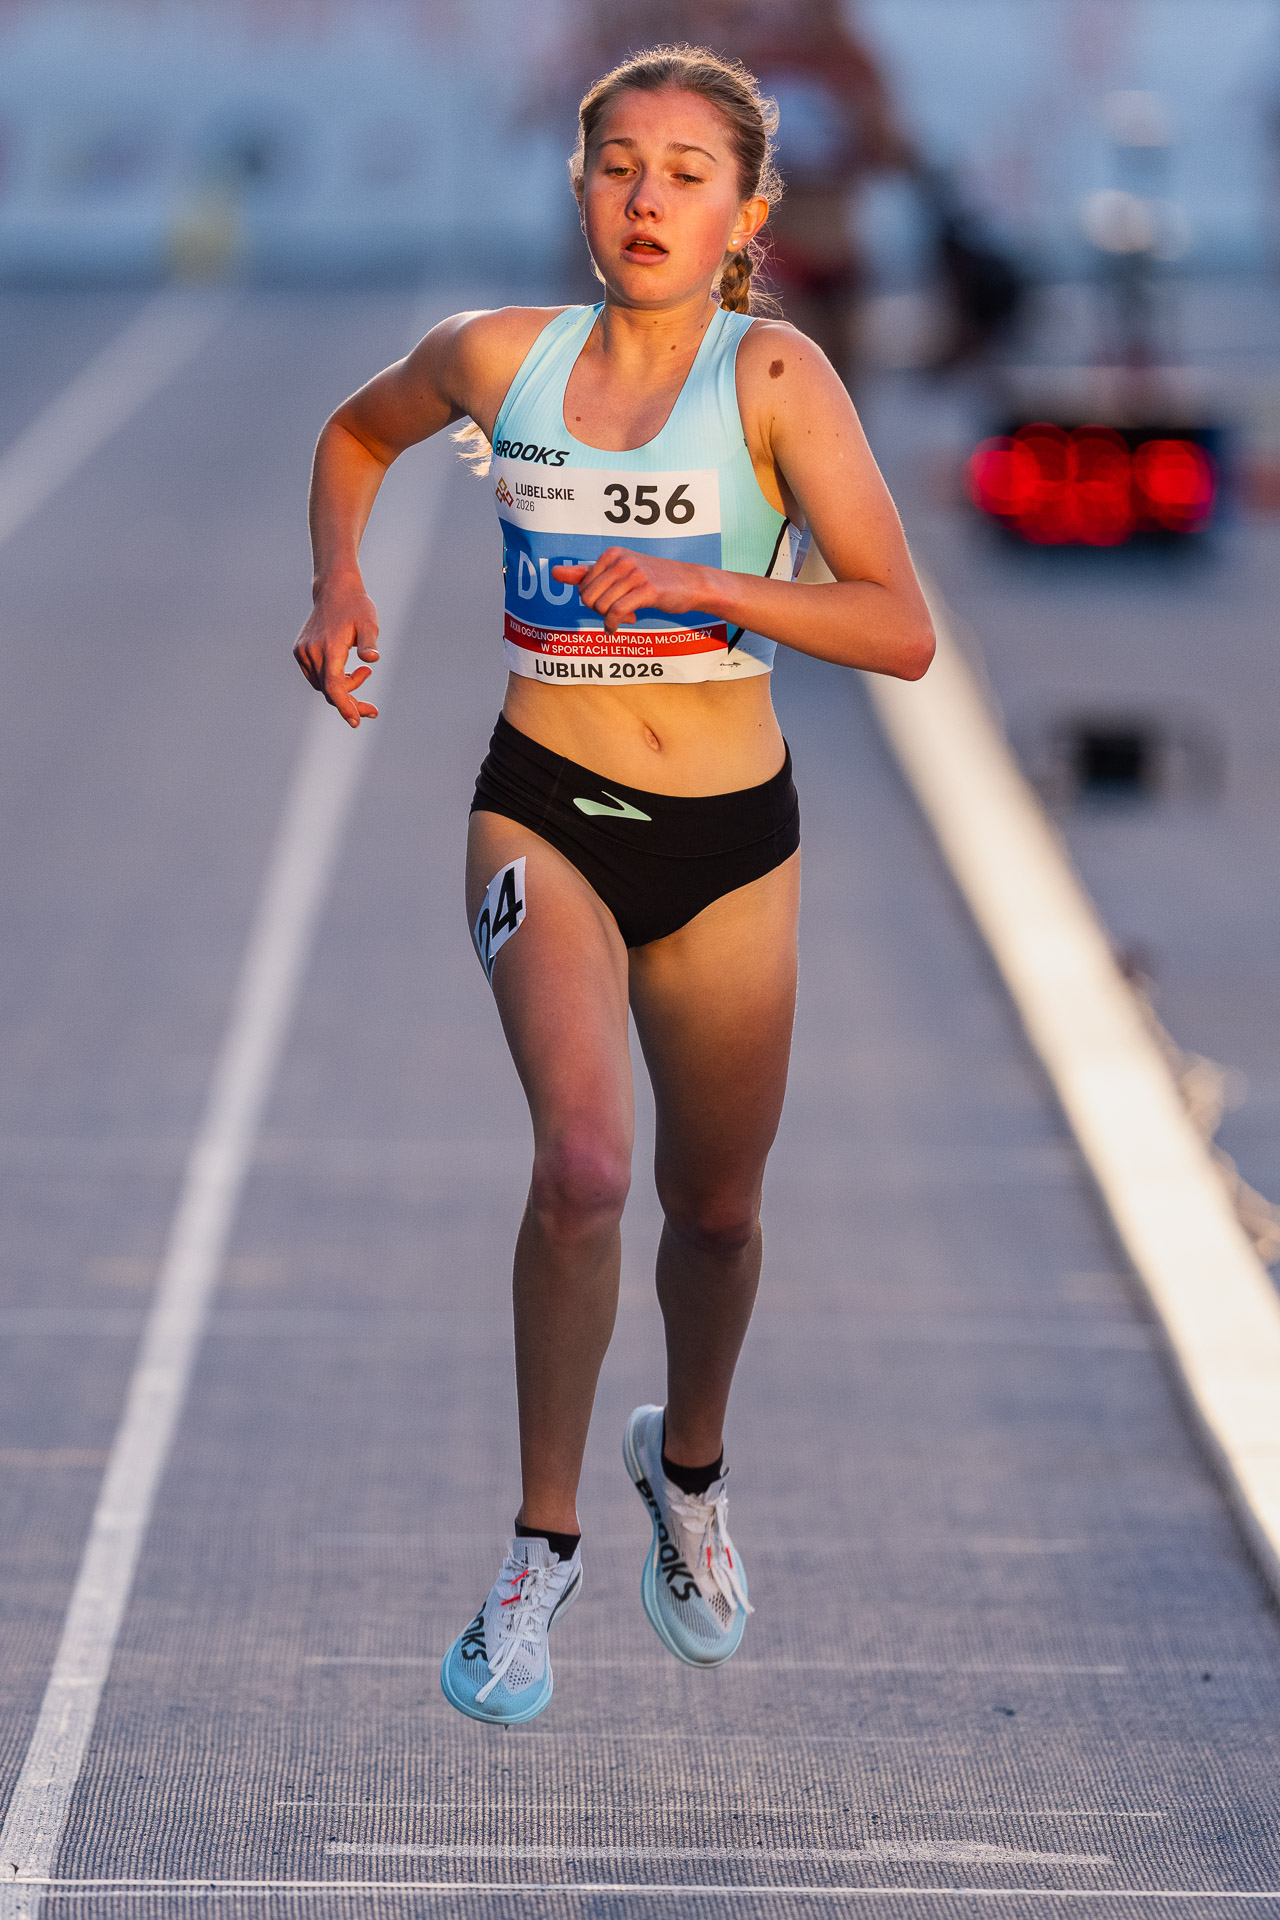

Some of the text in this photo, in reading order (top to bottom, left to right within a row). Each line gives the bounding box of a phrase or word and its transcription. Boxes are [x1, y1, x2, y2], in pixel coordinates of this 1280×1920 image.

[495, 440, 570, 467] BROOKS
[515, 482, 575, 501] LUBELSKIE
[515, 498, 535, 512] 2026
[603, 483, 695, 525] 356
[517, 549, 598, 607] DU
[521, 626, 593, 644] OGÓLNOPOLSKA
[595, 634, 653, 645] OLIMPIADA
[655, 629, 713, 645] MŁODZIEŻY
[541, 643, 654, 656] W SPORTACH LETNICH
[535, 659, 664, 679] LUBLIN 2026
[461, 1601, 489, 1662] OKS
